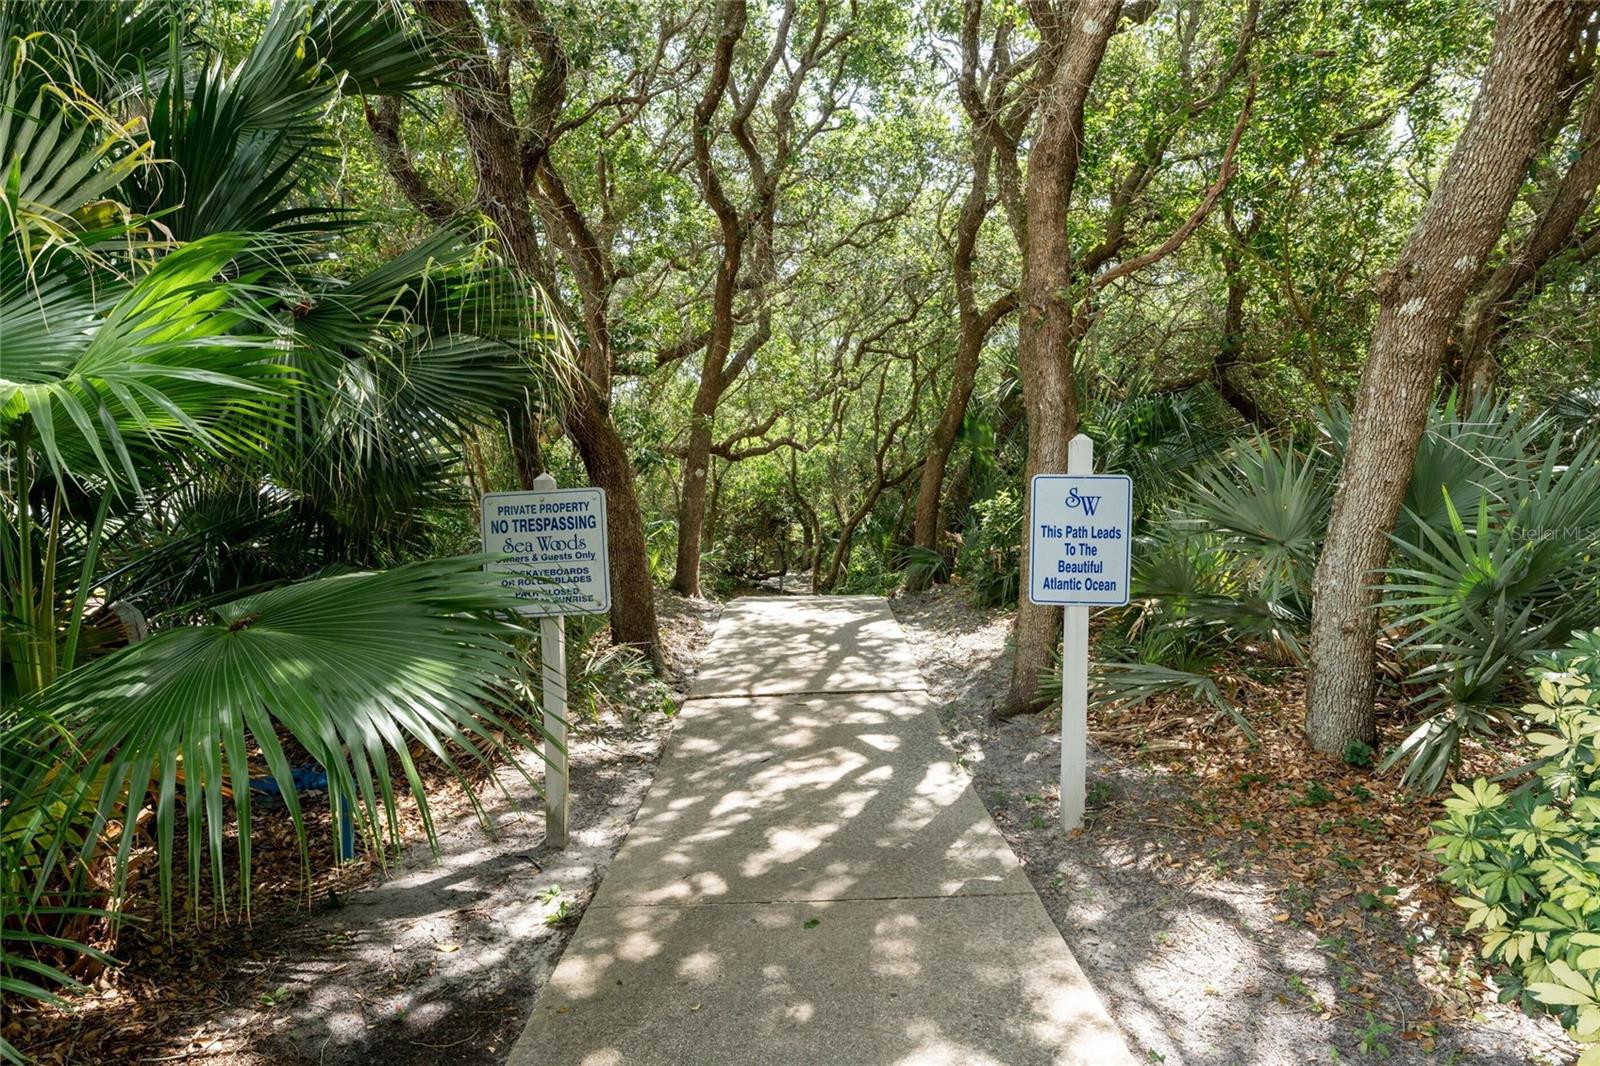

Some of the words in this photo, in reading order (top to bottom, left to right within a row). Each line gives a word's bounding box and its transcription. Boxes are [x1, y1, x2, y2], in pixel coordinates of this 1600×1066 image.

[498, 505, 536, 516] PRIVATE
[539, 501, 590, 513] PROPERTY
[1065, 487, 1101, 516] SW
[491, 520, 508, 534] NO
[512, 515, 596, 532] TRESPASSING
[1040, 525, 1062, 538] This
[1066, 526, 1088, 538] Path
[1091, 526, 1121, 539] Leads
[502, 538, 533, 553] Sea
[536, 533, 586, 552] Woods
[1064, 543, 1076, 556] To
[1079, 543, 1097, 556] The
[532, 554, 538, 562] &
[541, 552, 572, 561] Guests
[576, 551, 596, 560] Only
[1058, 560, 1103, 573] Beautiful
[1043, 577, 1081, 590] Atlantic
[1085, 578, 1116, 591] Ocean
